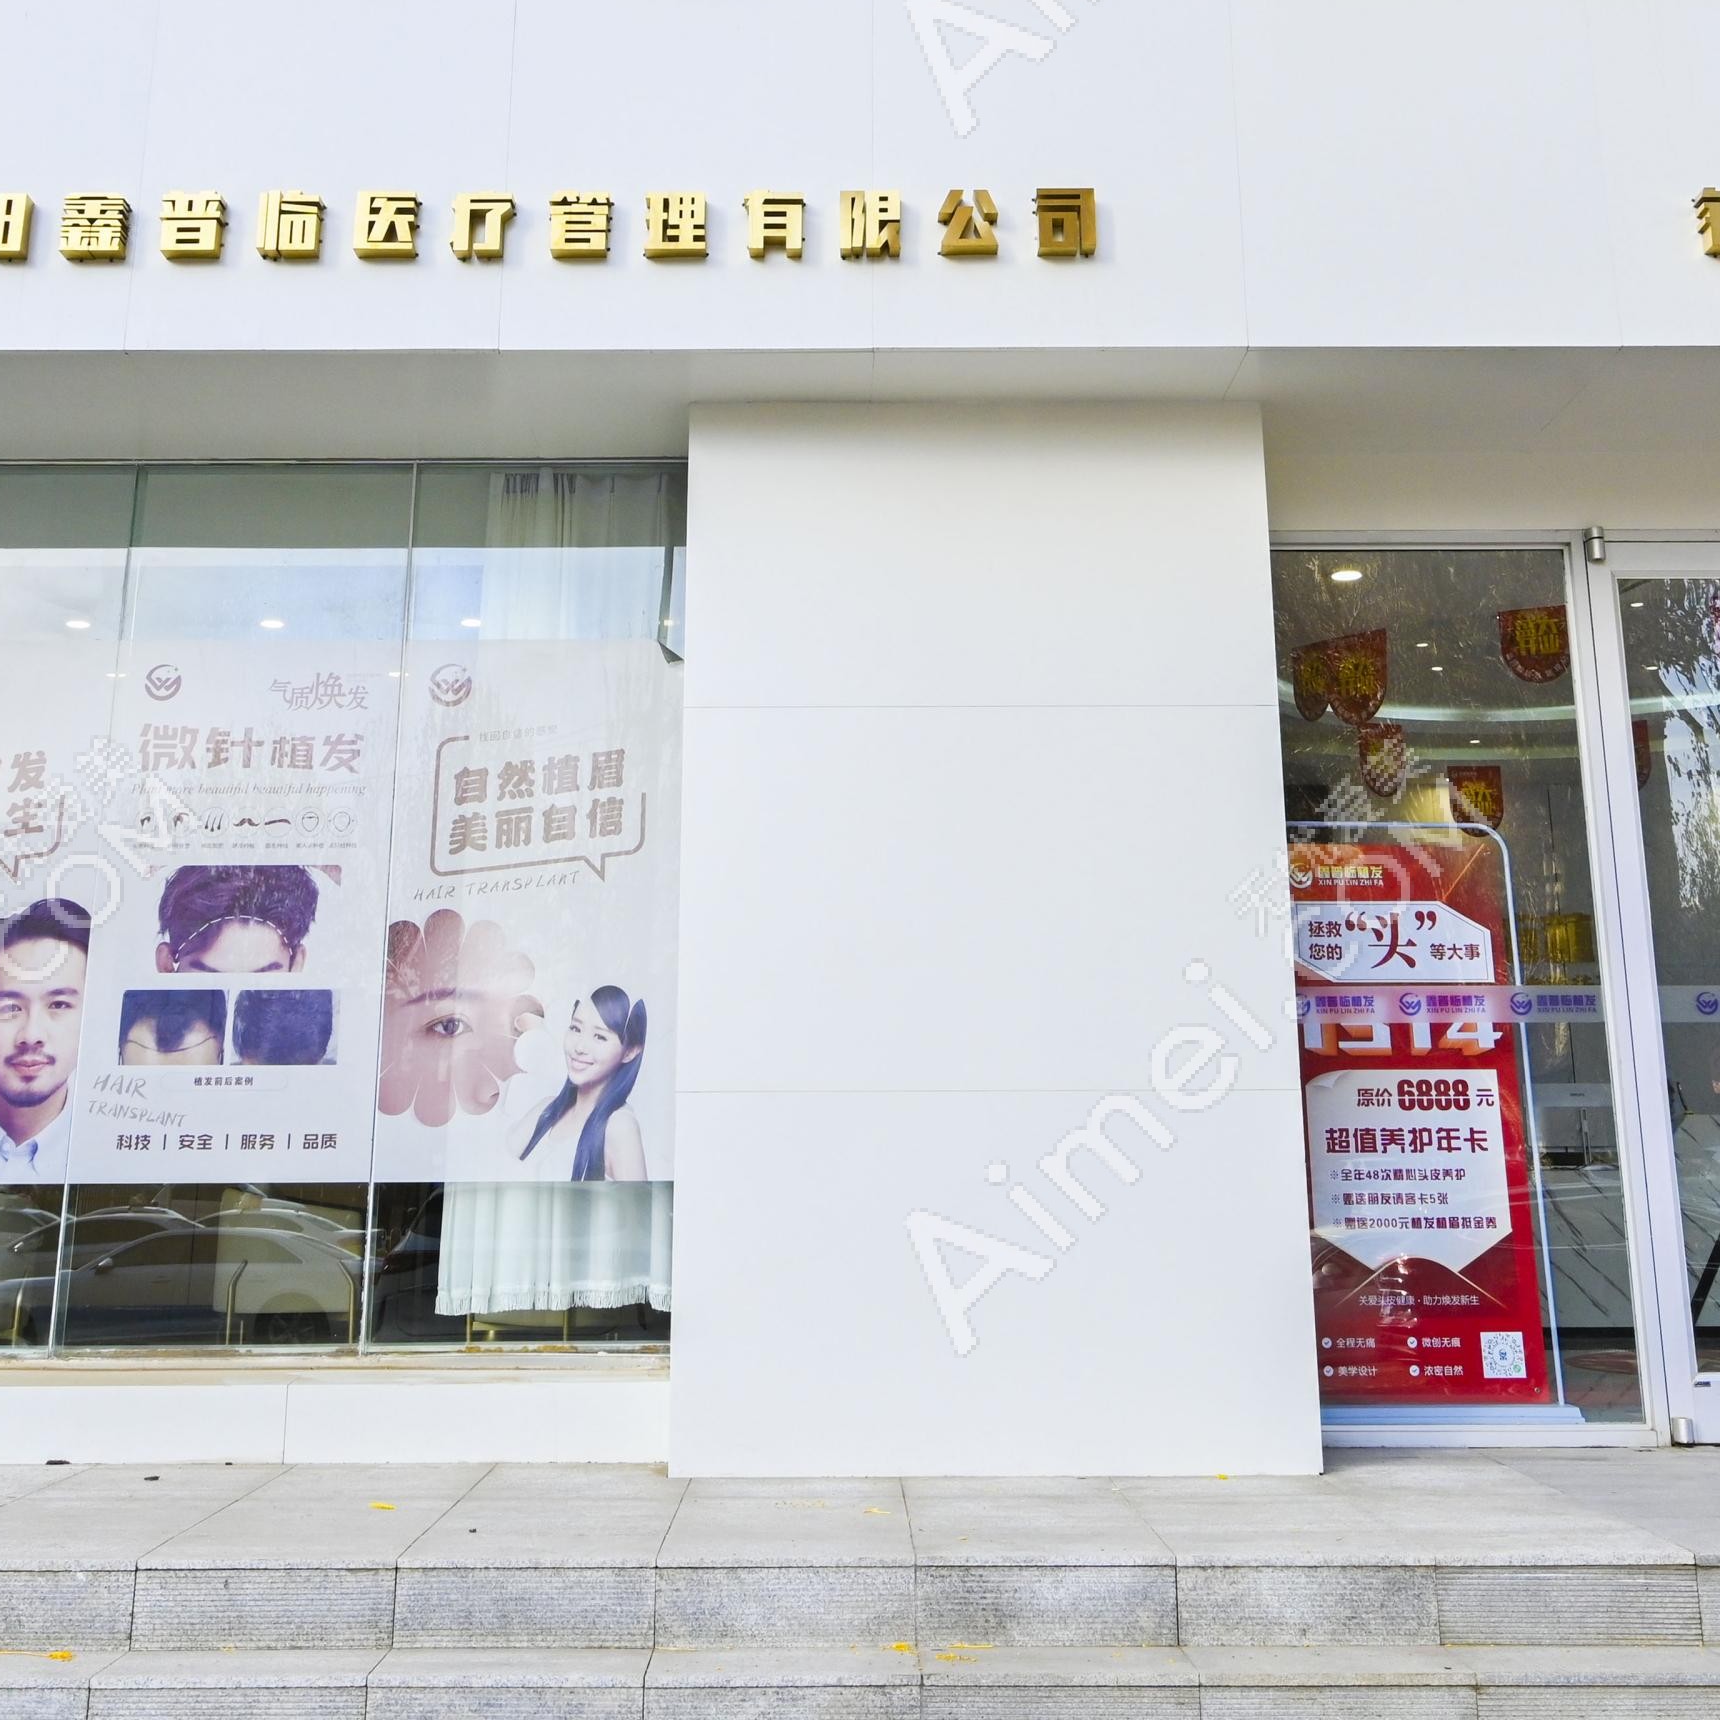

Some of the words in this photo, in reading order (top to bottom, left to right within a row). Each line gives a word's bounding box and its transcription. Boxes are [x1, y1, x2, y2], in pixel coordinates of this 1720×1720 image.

[270, 672, 369, 712] 气质焕发
[453, 749, 626, 807] 自然植眉
[448, 796, 625, 856] 美丽自信
[1308, 921, 1342, 938] 拯救
[1309, 943, 1342, 960] 您的
[1430, 943, 1480, 960] 等大事
[193, 1077, 254, 1087] 植发前后案例
[116, 1134, 151, 1151] 科技
[178, 1134, 213, 1150] 安全
[240, 1134, 275, 1150] 服务
[303, 1133, 338, 1150] 品质
[1325, 1128, 1489, 1153] 超值养护年卡
[1338, 1366, 1377, 1376] 美学设计
[1424, 1366, 1463, 1375] 浓密自然
